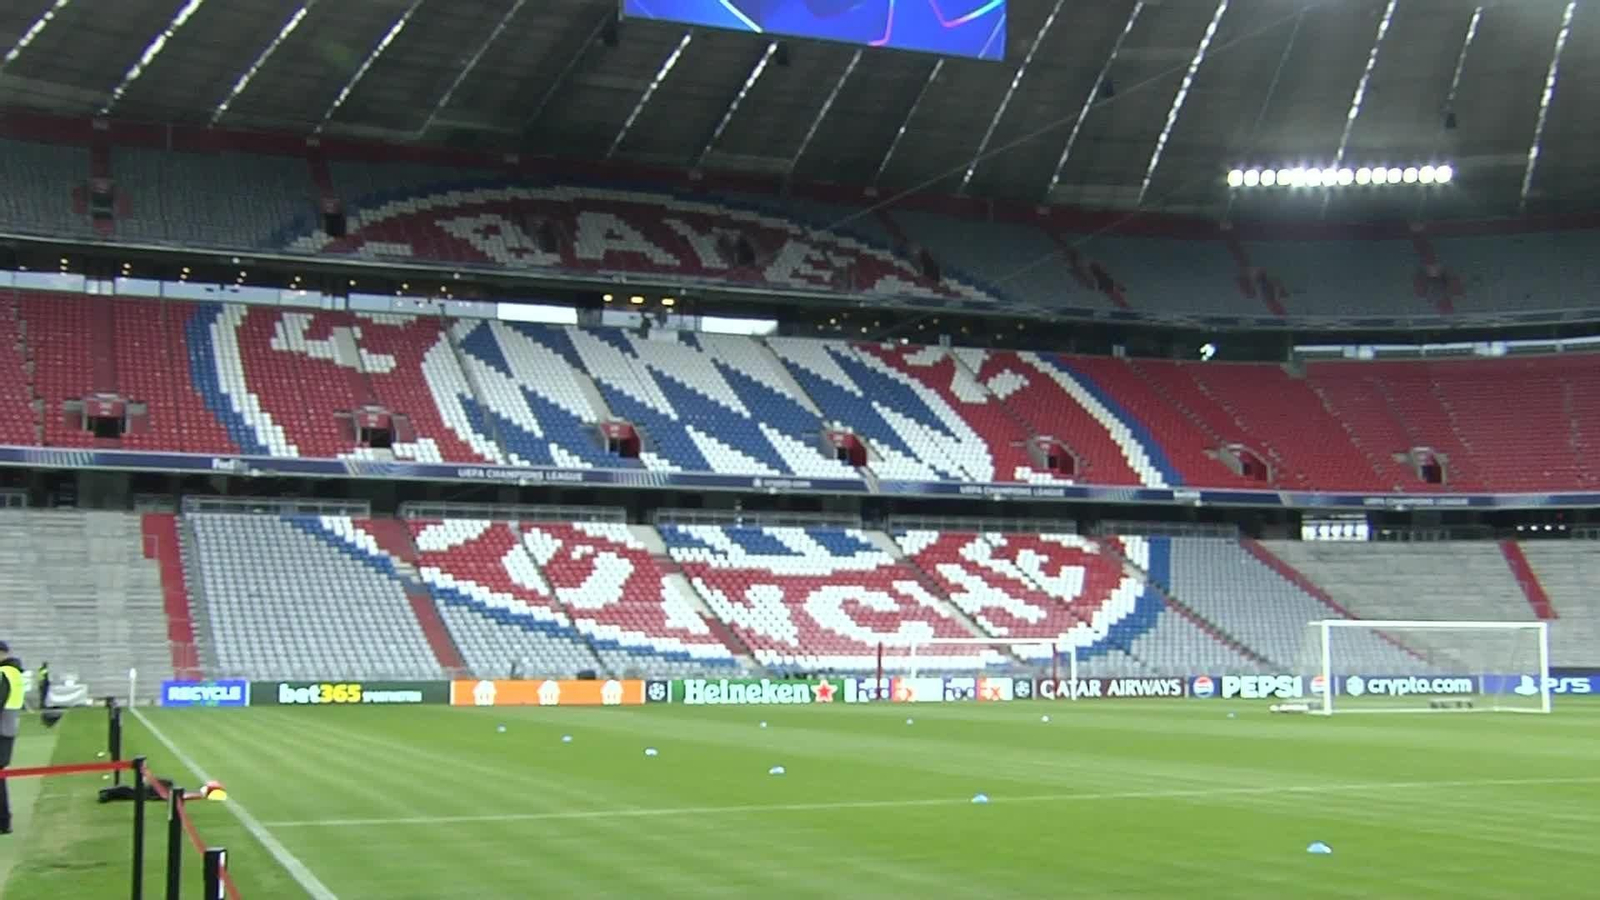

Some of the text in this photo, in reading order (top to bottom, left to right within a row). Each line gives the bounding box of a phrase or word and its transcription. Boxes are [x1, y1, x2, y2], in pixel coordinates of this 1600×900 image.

[458, 468, 582, 481] UEFA CHAMPIONS LEAGUE
[168, 686, 241, 701] RECYCLE
[279, 683, 361, 703] bet365
[684, 680, 811, 704] Heineken
[1040, 679, 1182, 699] QATAR AIRWAYS
[1221, 676, 1301, 698] PEPSI
[1368, 677, 1472, 695] crypto.com
[1541, 677, 1591, 693] PS5
